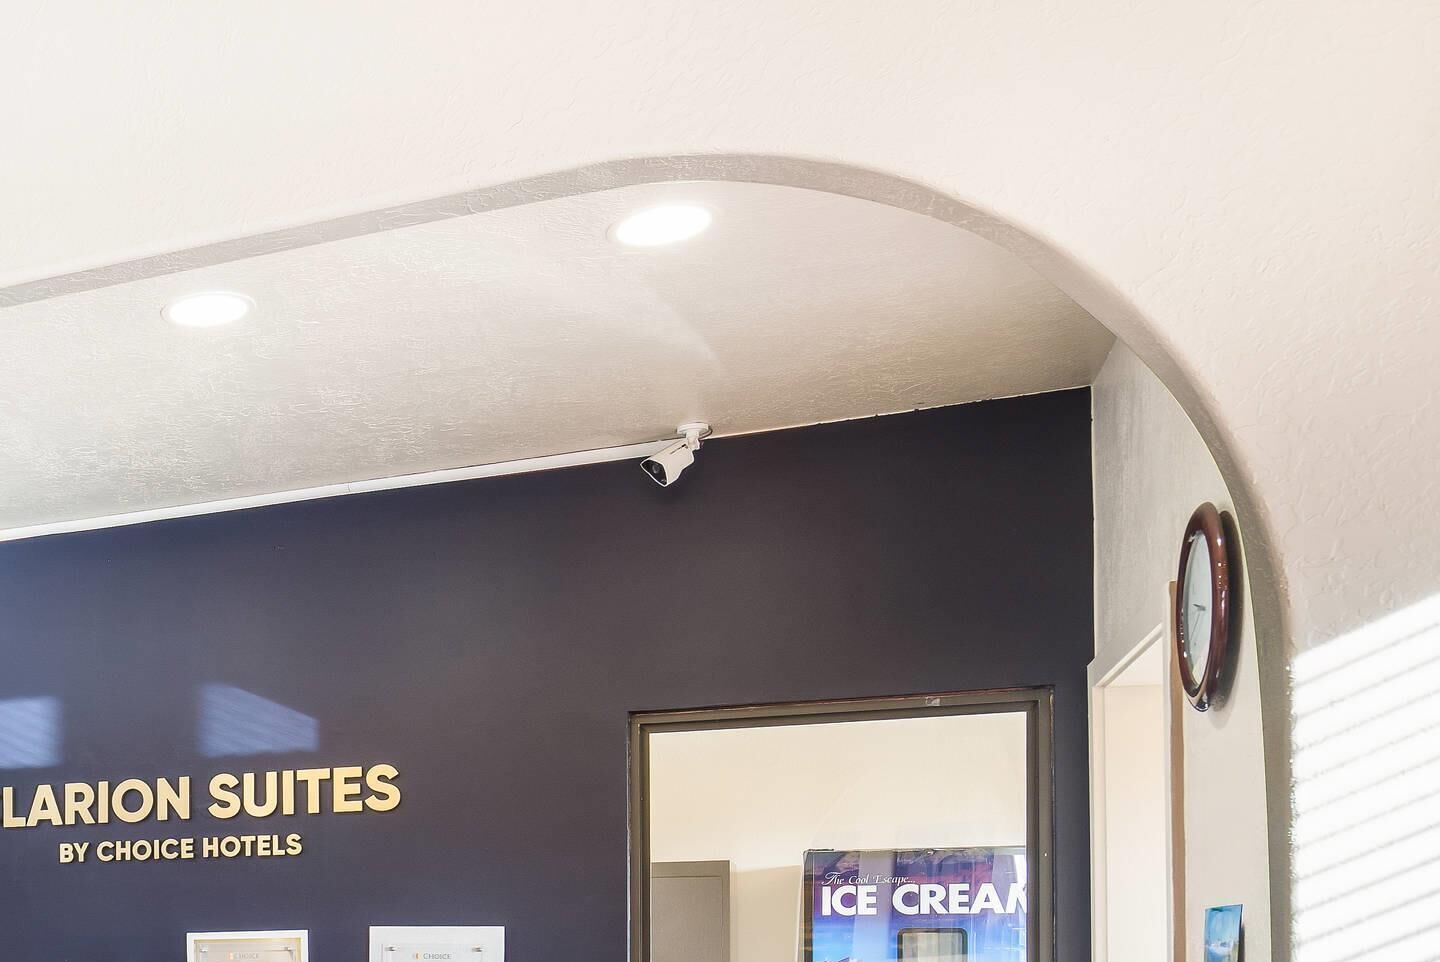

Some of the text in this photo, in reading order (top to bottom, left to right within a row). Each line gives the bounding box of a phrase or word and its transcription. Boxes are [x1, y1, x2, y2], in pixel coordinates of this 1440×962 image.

[207, 763, 402, 820] SUITES
[58, 833, 303, 864] BY CHOICE HOTELS
[821, 871, 845, 886] The
[848, 873, 870, 885] Cool
[821, 884, 878, 917] ICE
[422, 952, 453, 961] CHOICE
